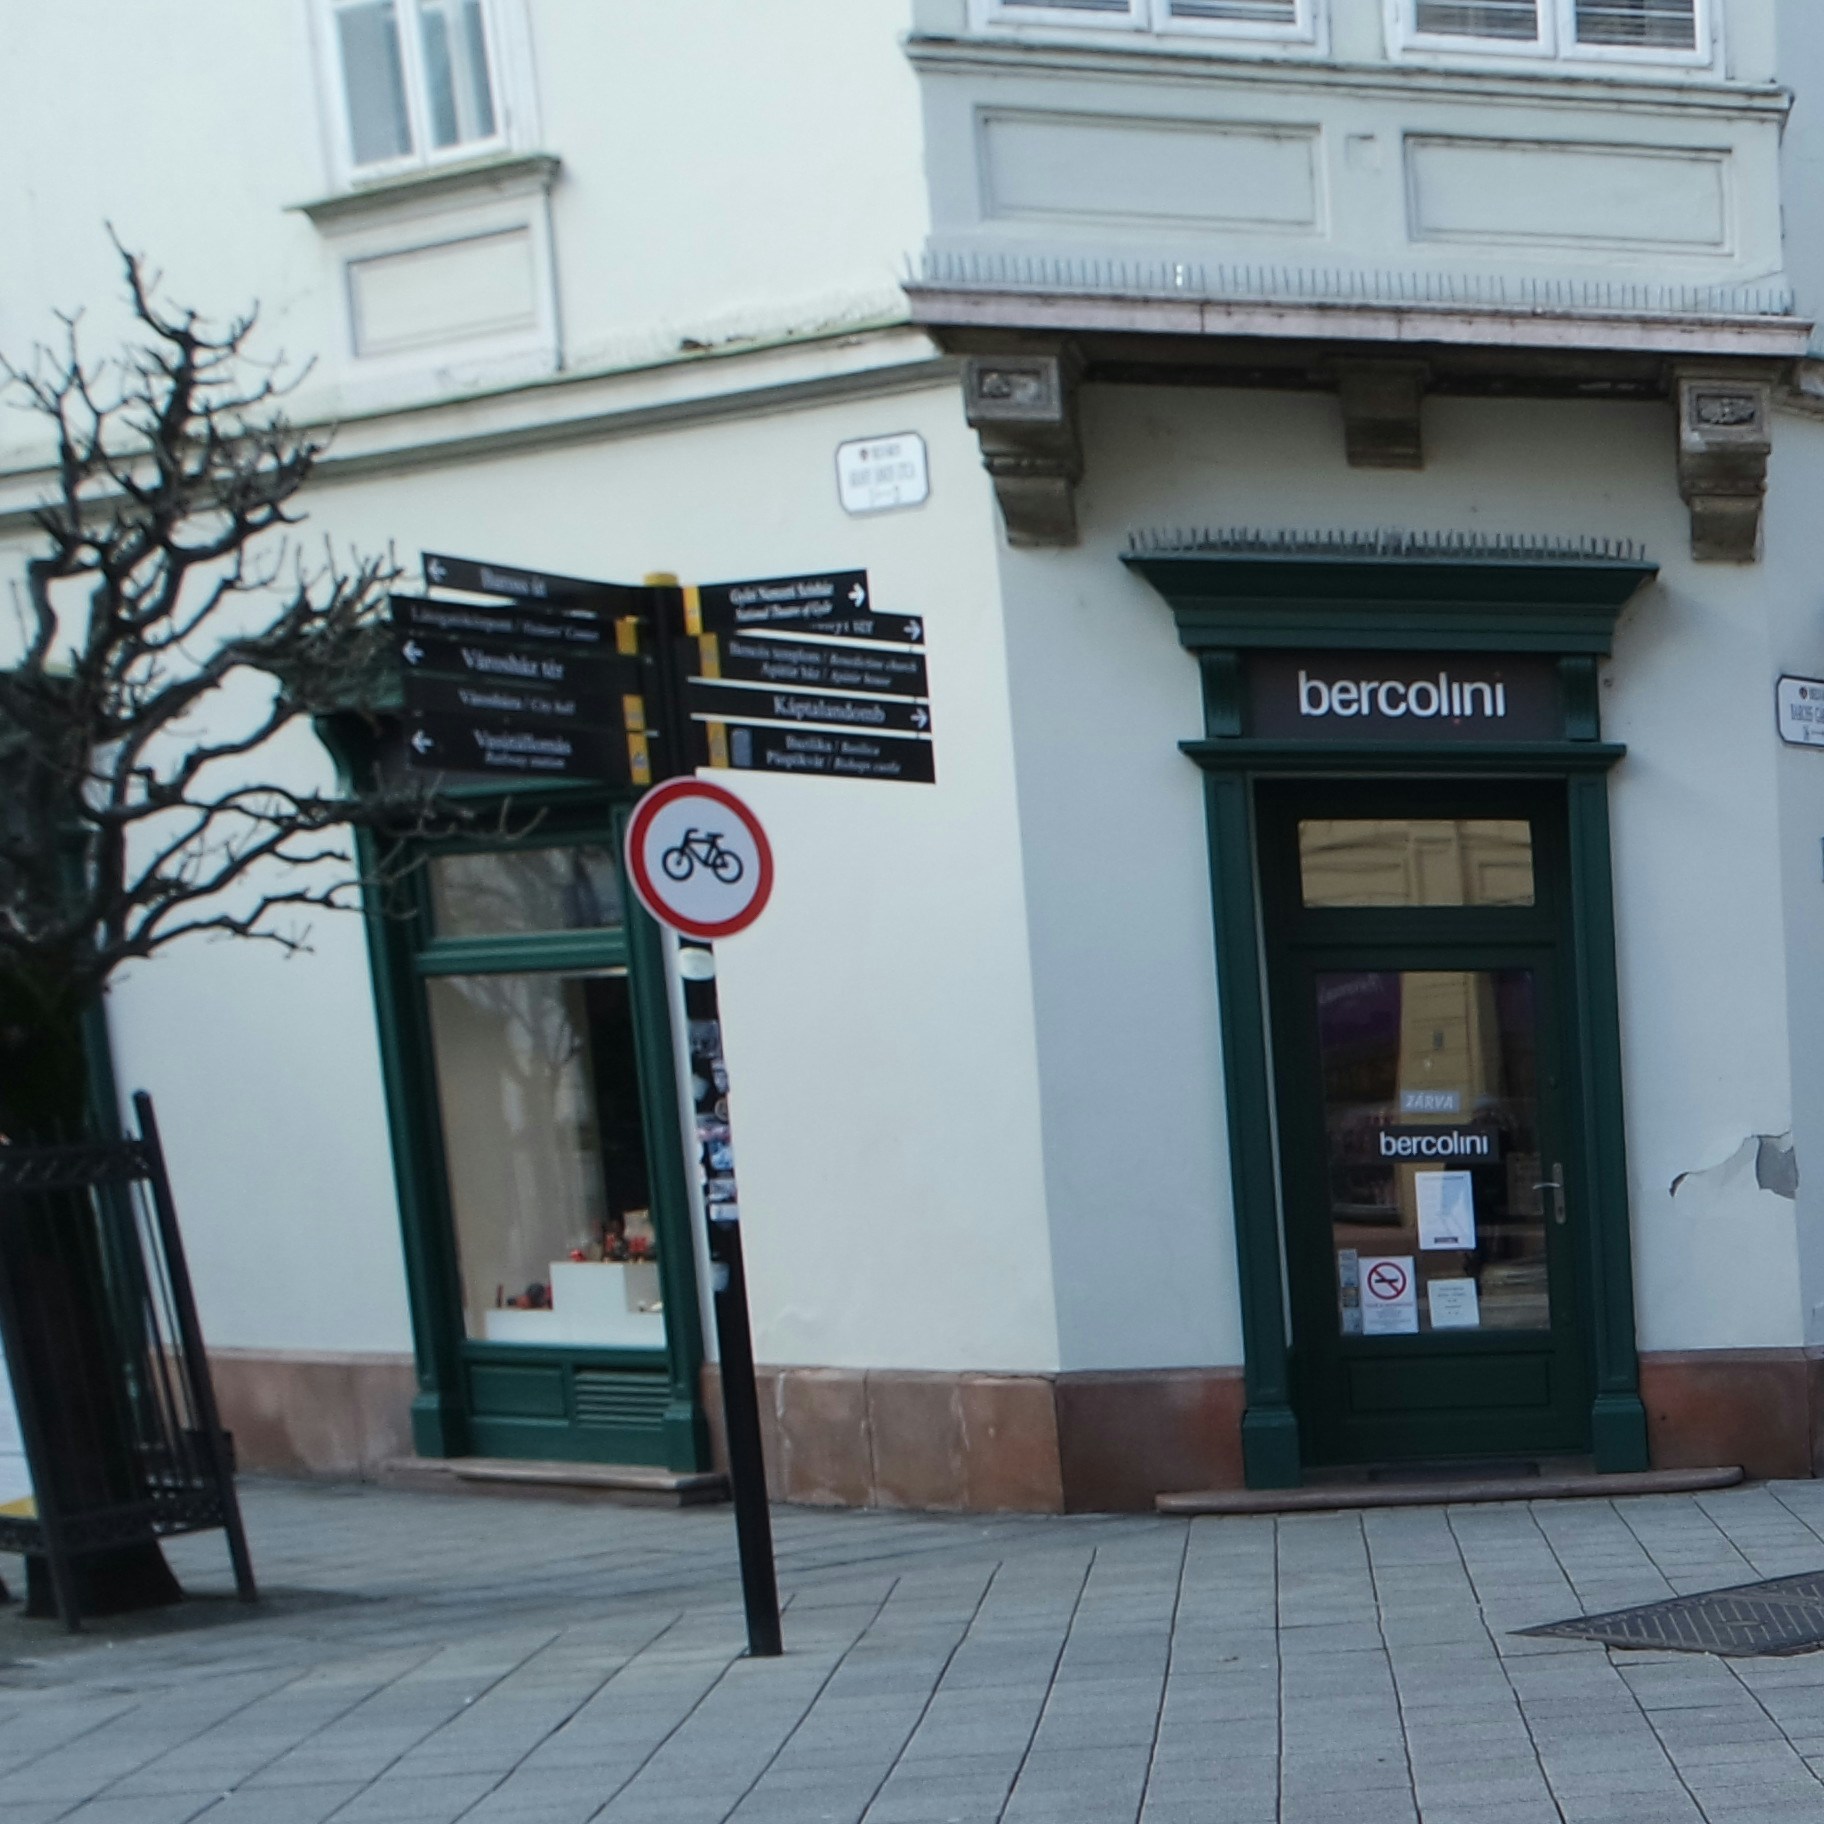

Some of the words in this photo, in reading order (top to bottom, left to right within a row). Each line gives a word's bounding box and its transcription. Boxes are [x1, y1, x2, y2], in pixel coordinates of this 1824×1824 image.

[1298, 670, 1506, 718] bercolini
[1405, 1091, 1454, 1110] ZÁRVA
[1379, 1130, 1489, 1156] bercolini
